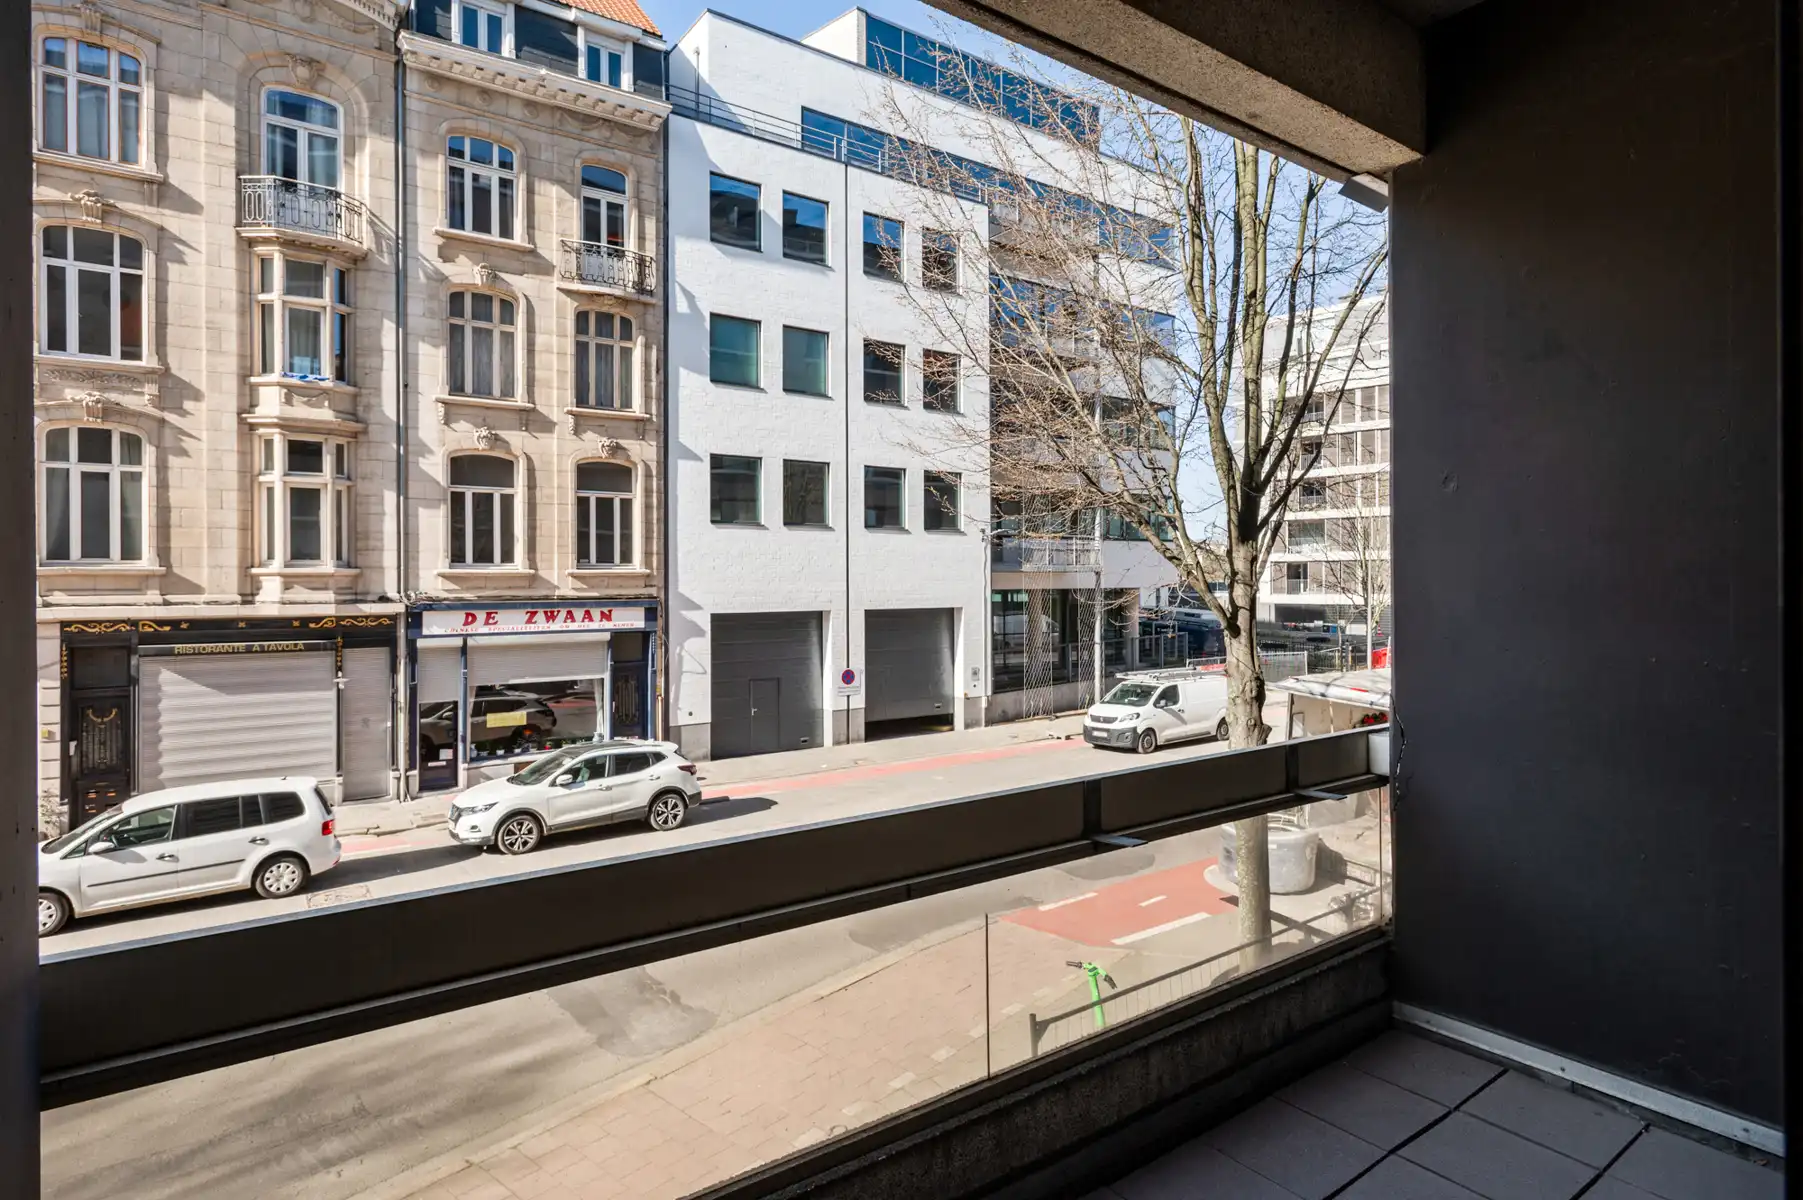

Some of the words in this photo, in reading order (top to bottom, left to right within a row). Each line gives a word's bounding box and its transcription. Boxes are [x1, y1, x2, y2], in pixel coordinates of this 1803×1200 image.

[462, 611, 499, 626] DE
[524, 609, 613, 625] ZWAAN
[174, 644, 246, 654] RISTORANTE
[252, 644, 260, 652] A
[263, 643, 305, 652] TAVOLA
